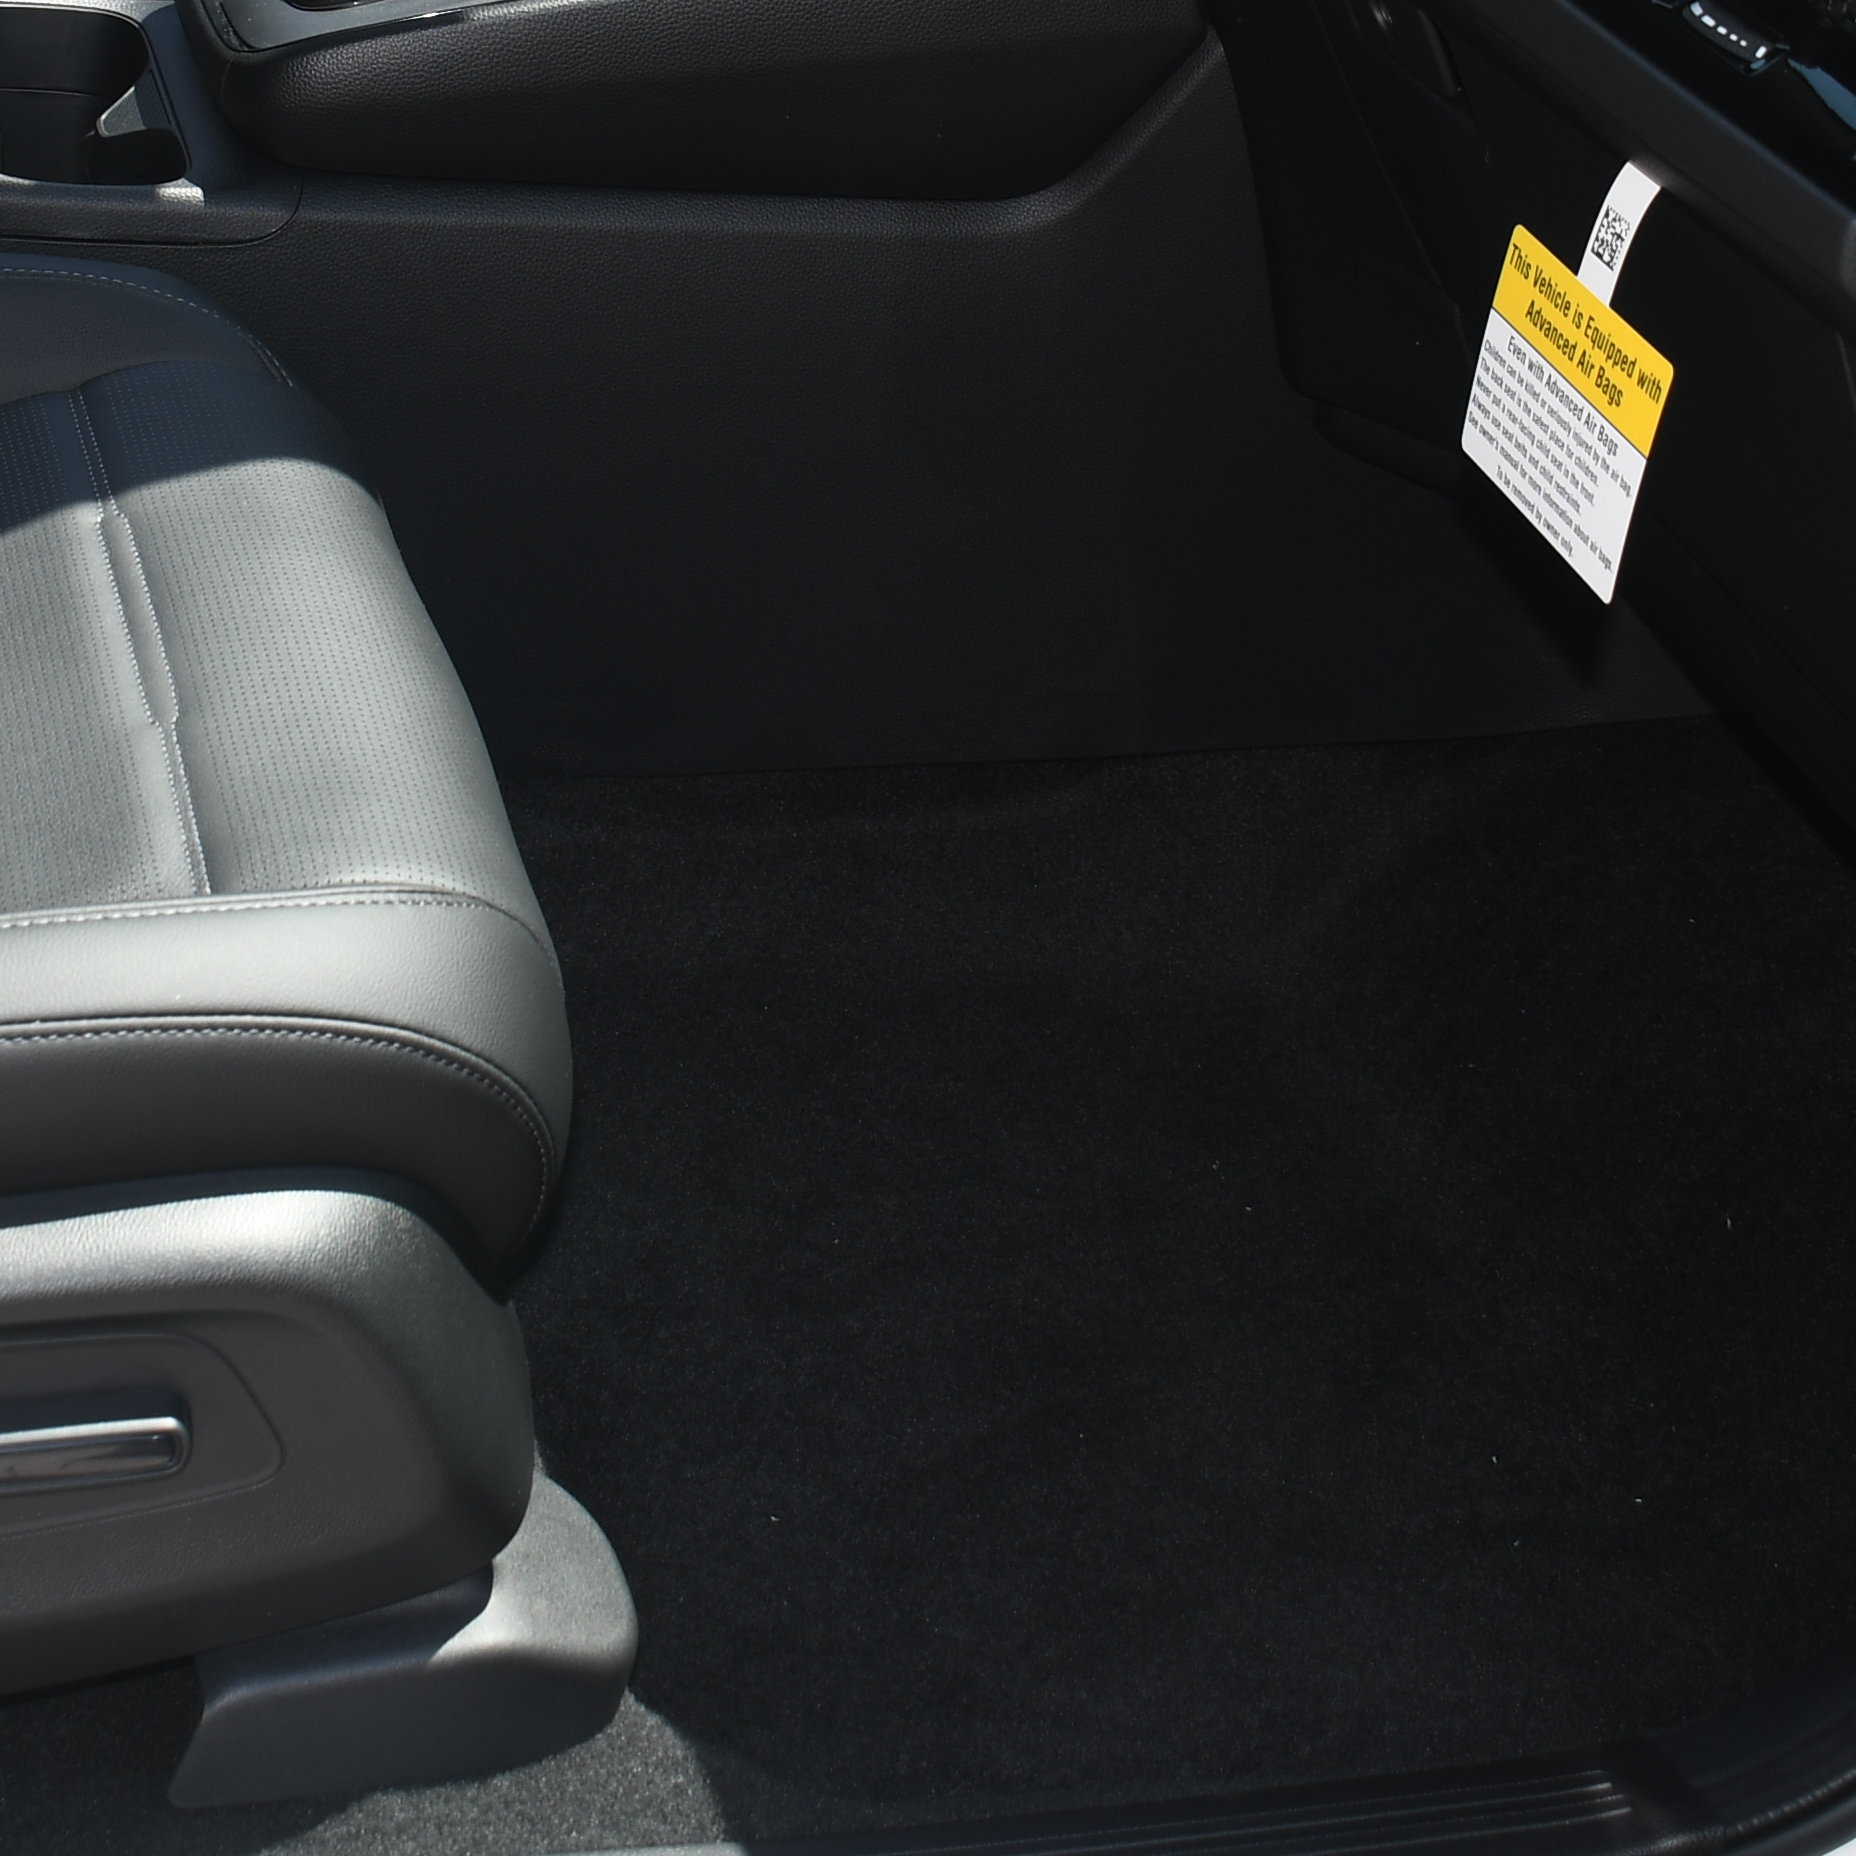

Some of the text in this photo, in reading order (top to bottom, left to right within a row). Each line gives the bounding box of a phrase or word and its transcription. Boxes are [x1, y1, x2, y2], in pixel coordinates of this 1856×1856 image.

[1510, 243, 1661, 404] This Vehicle is Equipped with
[1525, 300, 1623, 407] Advanced Air Bags
[1491, 368, 1503, 389] back
[1504, 384, 1516, 402] seat
[1508, 336, 1618, 456] Even with Advanced Air Bags
